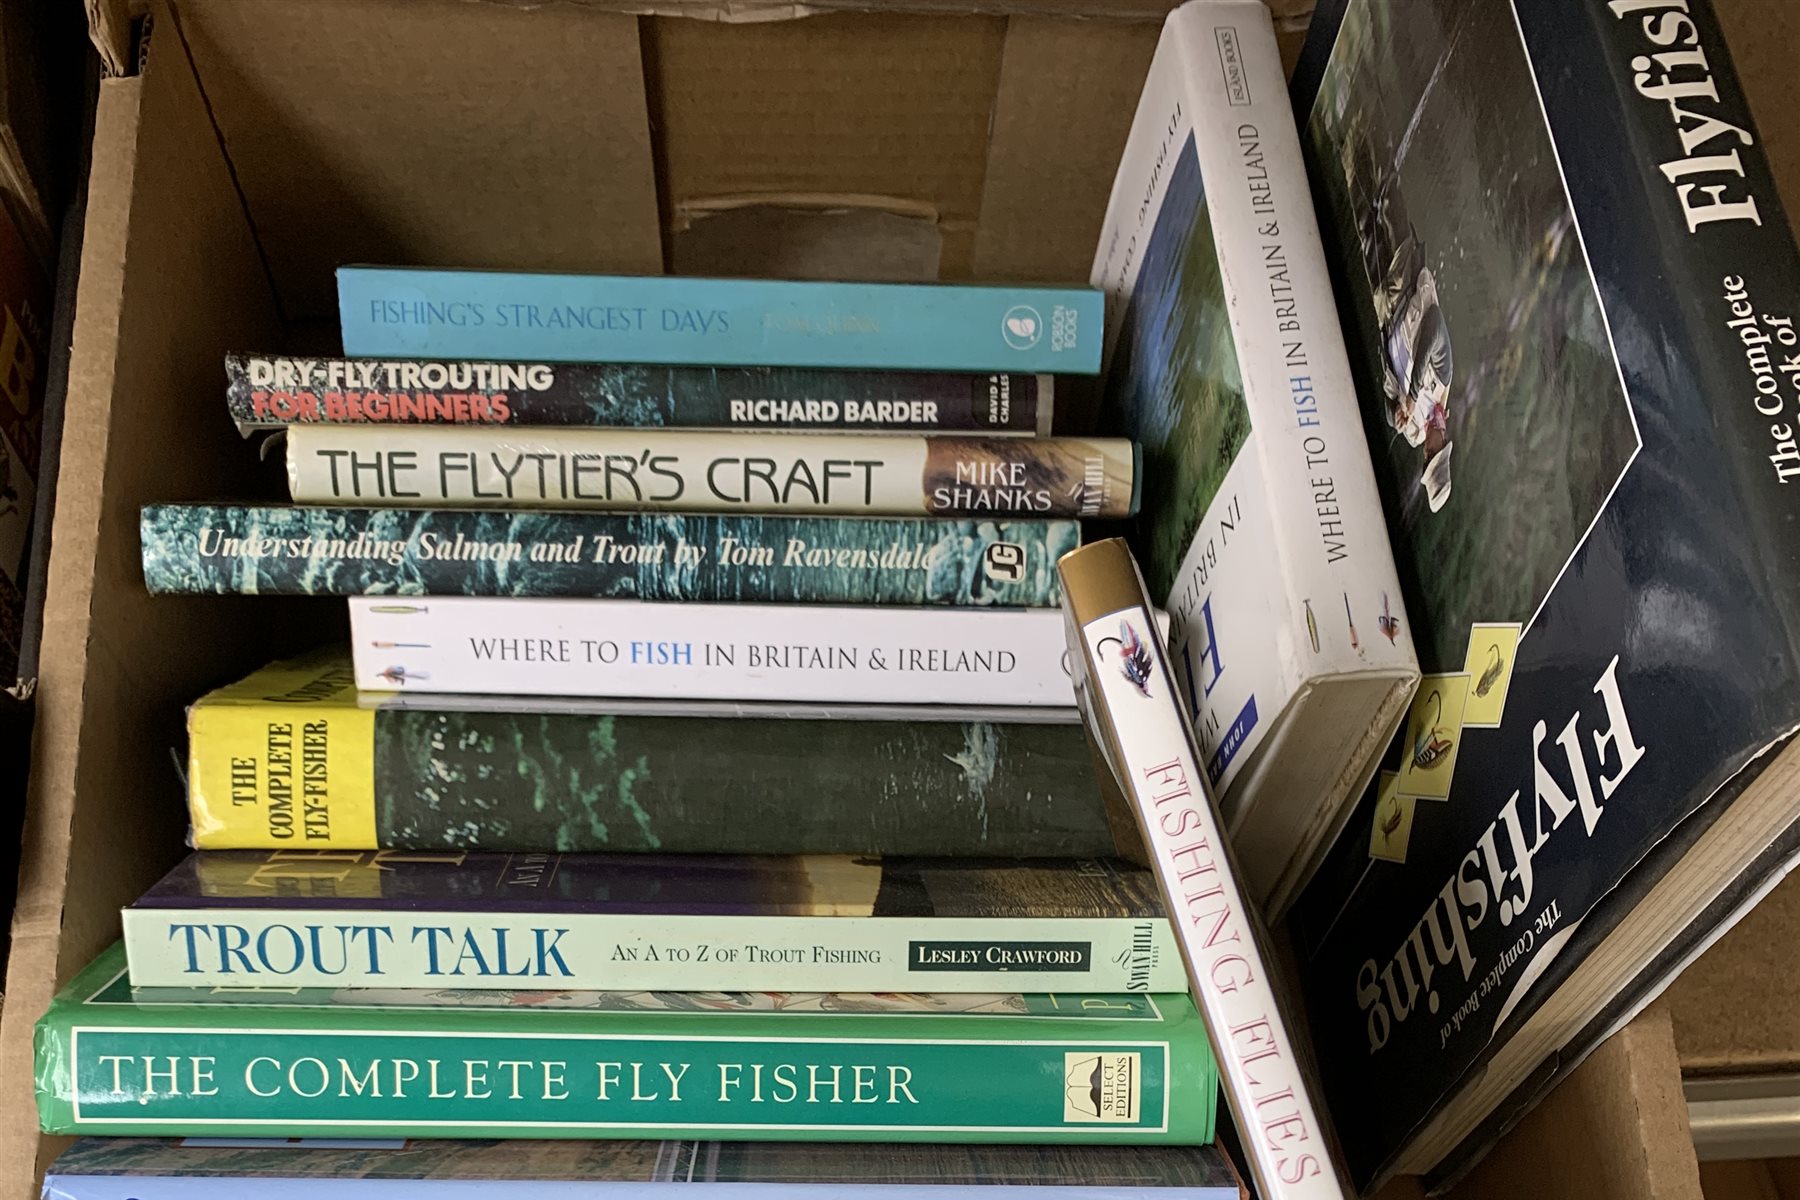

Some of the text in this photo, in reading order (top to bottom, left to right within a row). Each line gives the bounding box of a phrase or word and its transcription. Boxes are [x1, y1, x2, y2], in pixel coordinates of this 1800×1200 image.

[370, 299, 485, 327] FISHING'S
[496, 303, 646, 333] STRANGEST
[1064, 308, 1078, 348] BOOKS
[1762, 313, 1798, 356] of
[1237, 123, 1349, 564] WHERE TO FISH IN BRITAIN & IRELAND
[1723, 274, 1784, 416] Complete
[249, 359, 555, 391] DRY-FLY TROUTING
[1000, 374, 1009, 424] CHARLES
[251, 391, 512, 424] FOR BEGINNERS
[730, 399, 939, 424] RICHARD BARDER
[989, 385, 998, 423] DAVID
[316, 448, 884, 506] THE FLYTIER'S CRAFT
[955, 460, 1027, 488] MIKE
[1769, 422, 1800, 484] The
[932, 487, 1053, 512] SHANKS
[199, 529, 408, 566] Understanding
[417, 533, 524, 564] Salmon
[530, 537, 583, 565] and
[591, 534, 666, 567] Trout
[674, 537, 707, 568] by
[717, 537, 775, 567] Tom
[469, 636, 1017, 674] WHERE TO FISH IN BRITAIN & IRELAND
[231, 756, 258, 807] THE
[268, 721, 293, 840] COMPLETE
[303, 718, 329, 842] FLY-FISHER
[1356, 655, 1646, 1056] Flyfishing
[168, 922, 576, 978] TROUT TALK
[645, 944, 661, 962] A
[696, 945, 709, 963] Z
[1143, 756, 1322, 1185] FISHING FLIES
[1439, 898, 1563, 1050] The Complete Book of
[98, 1054, 920, 1105] THE COMPLETE FLY FISHER
[1103, 1063, 1114, 1111] SELECT
[1115, 1056, 1127, 1118] EDITIONS
